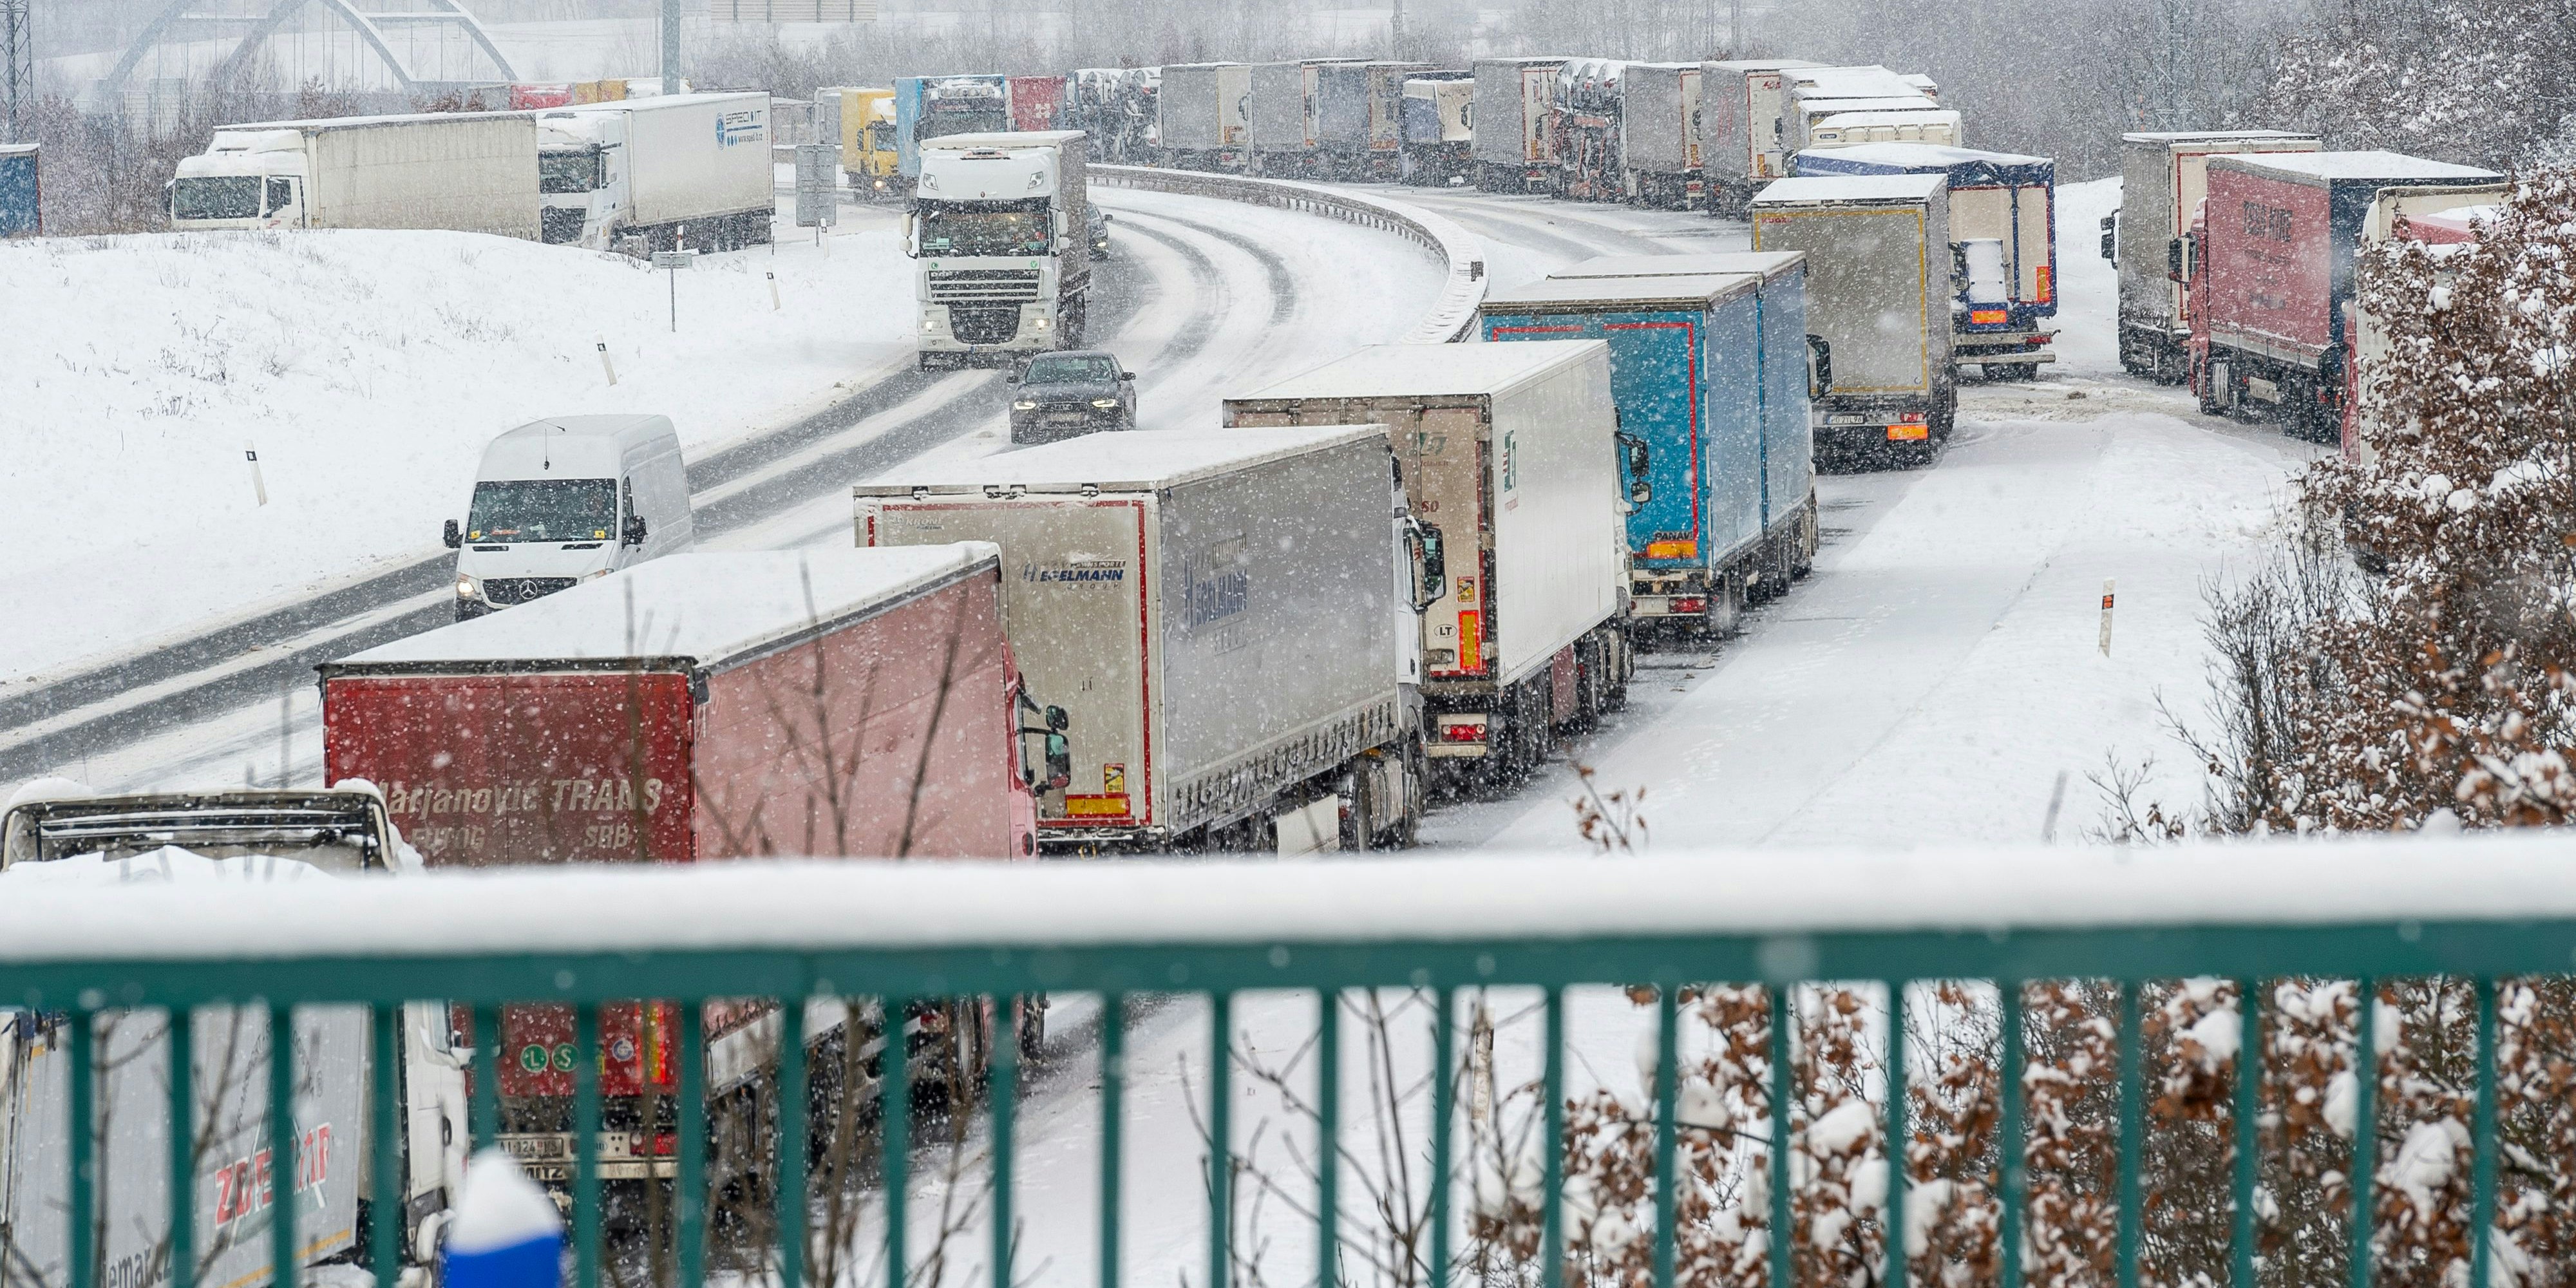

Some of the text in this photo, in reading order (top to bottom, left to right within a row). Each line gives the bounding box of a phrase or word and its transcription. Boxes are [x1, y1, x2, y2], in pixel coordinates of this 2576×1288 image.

[1655, 532, 1689, 540] PANAV
[1439, 627, 1452, 636] LT
[551, 778, 663, 812] TRANS
[585, 825, 629, 849] SRB
[216, 1122, 330, 1229] ZDEAR
